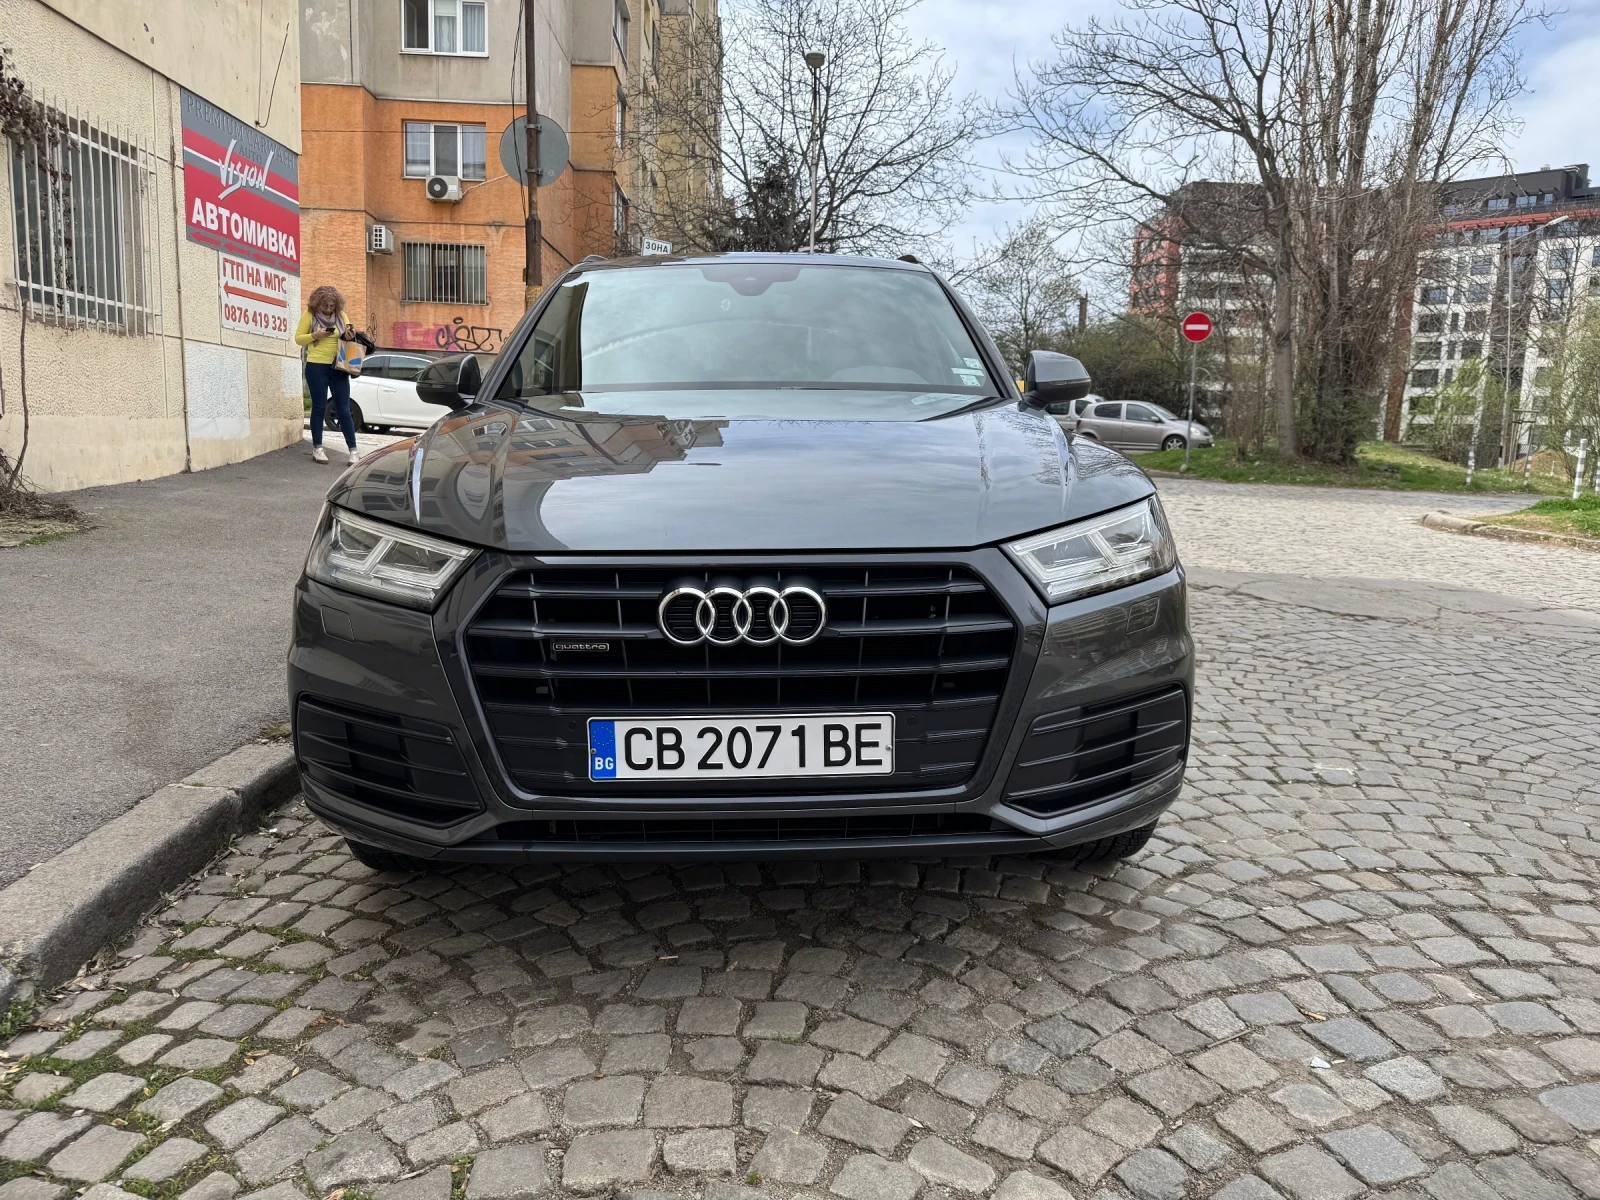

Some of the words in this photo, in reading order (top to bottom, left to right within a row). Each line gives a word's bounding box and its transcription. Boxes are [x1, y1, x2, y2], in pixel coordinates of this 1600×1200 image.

[187, 95, 245, 139] PREMIUM
[239, 145, 263, 165] AUTO
[191, 197, 297, 261] АВТОМИВКА
[645, 241, 668, 253] ЗОНА
[222, 257, 244, 283] ГТП
[246, 265, 262, 288] НА
[264, 271, 287, 295] МПС
[224, 303, 250, 325] 0876
[251, 310, 270, 330] 419
[271, 316, 288, 333] 329
[594, 757, 614, 770] BG
[624, 726, 685, 771] CB
[696, 724, 806, 769] 2071
[823, 722, 883, 768] BE
